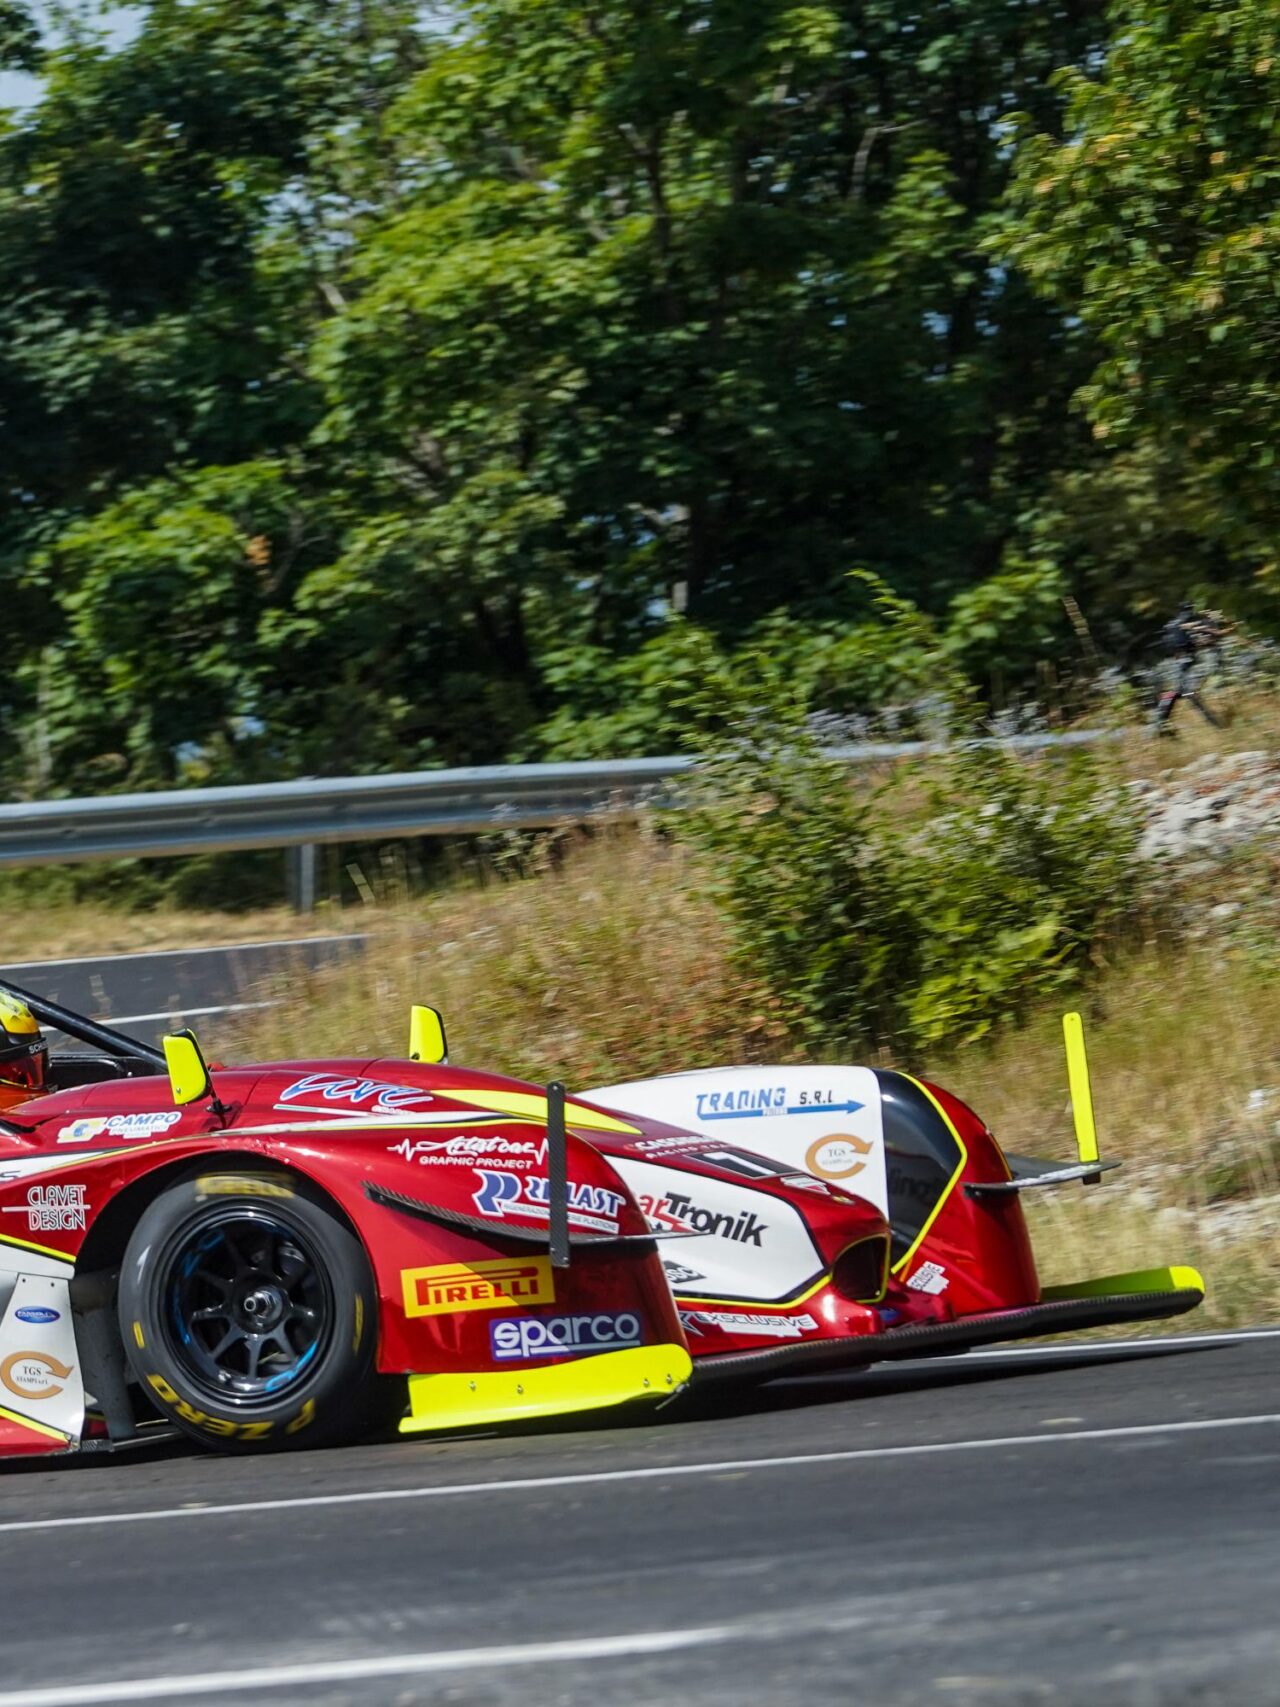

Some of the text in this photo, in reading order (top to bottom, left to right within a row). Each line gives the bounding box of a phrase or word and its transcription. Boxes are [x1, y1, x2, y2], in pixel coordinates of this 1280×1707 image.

[107, 1113, 179, 1127] CAMPO
[419, 1156, 533, 1169] GRAPHIC PROJECT
[27, 1185, 86, 1206] CLAVET
[29, 1209, 86, 1230] DESIGN
[640, 1191, 769, 1247] arTronik
[414, 1265, 539, 1307] PIRELLI
[493, 1313, 641, 1358] sparco
[23, 1366, 41, 1376] TGS
